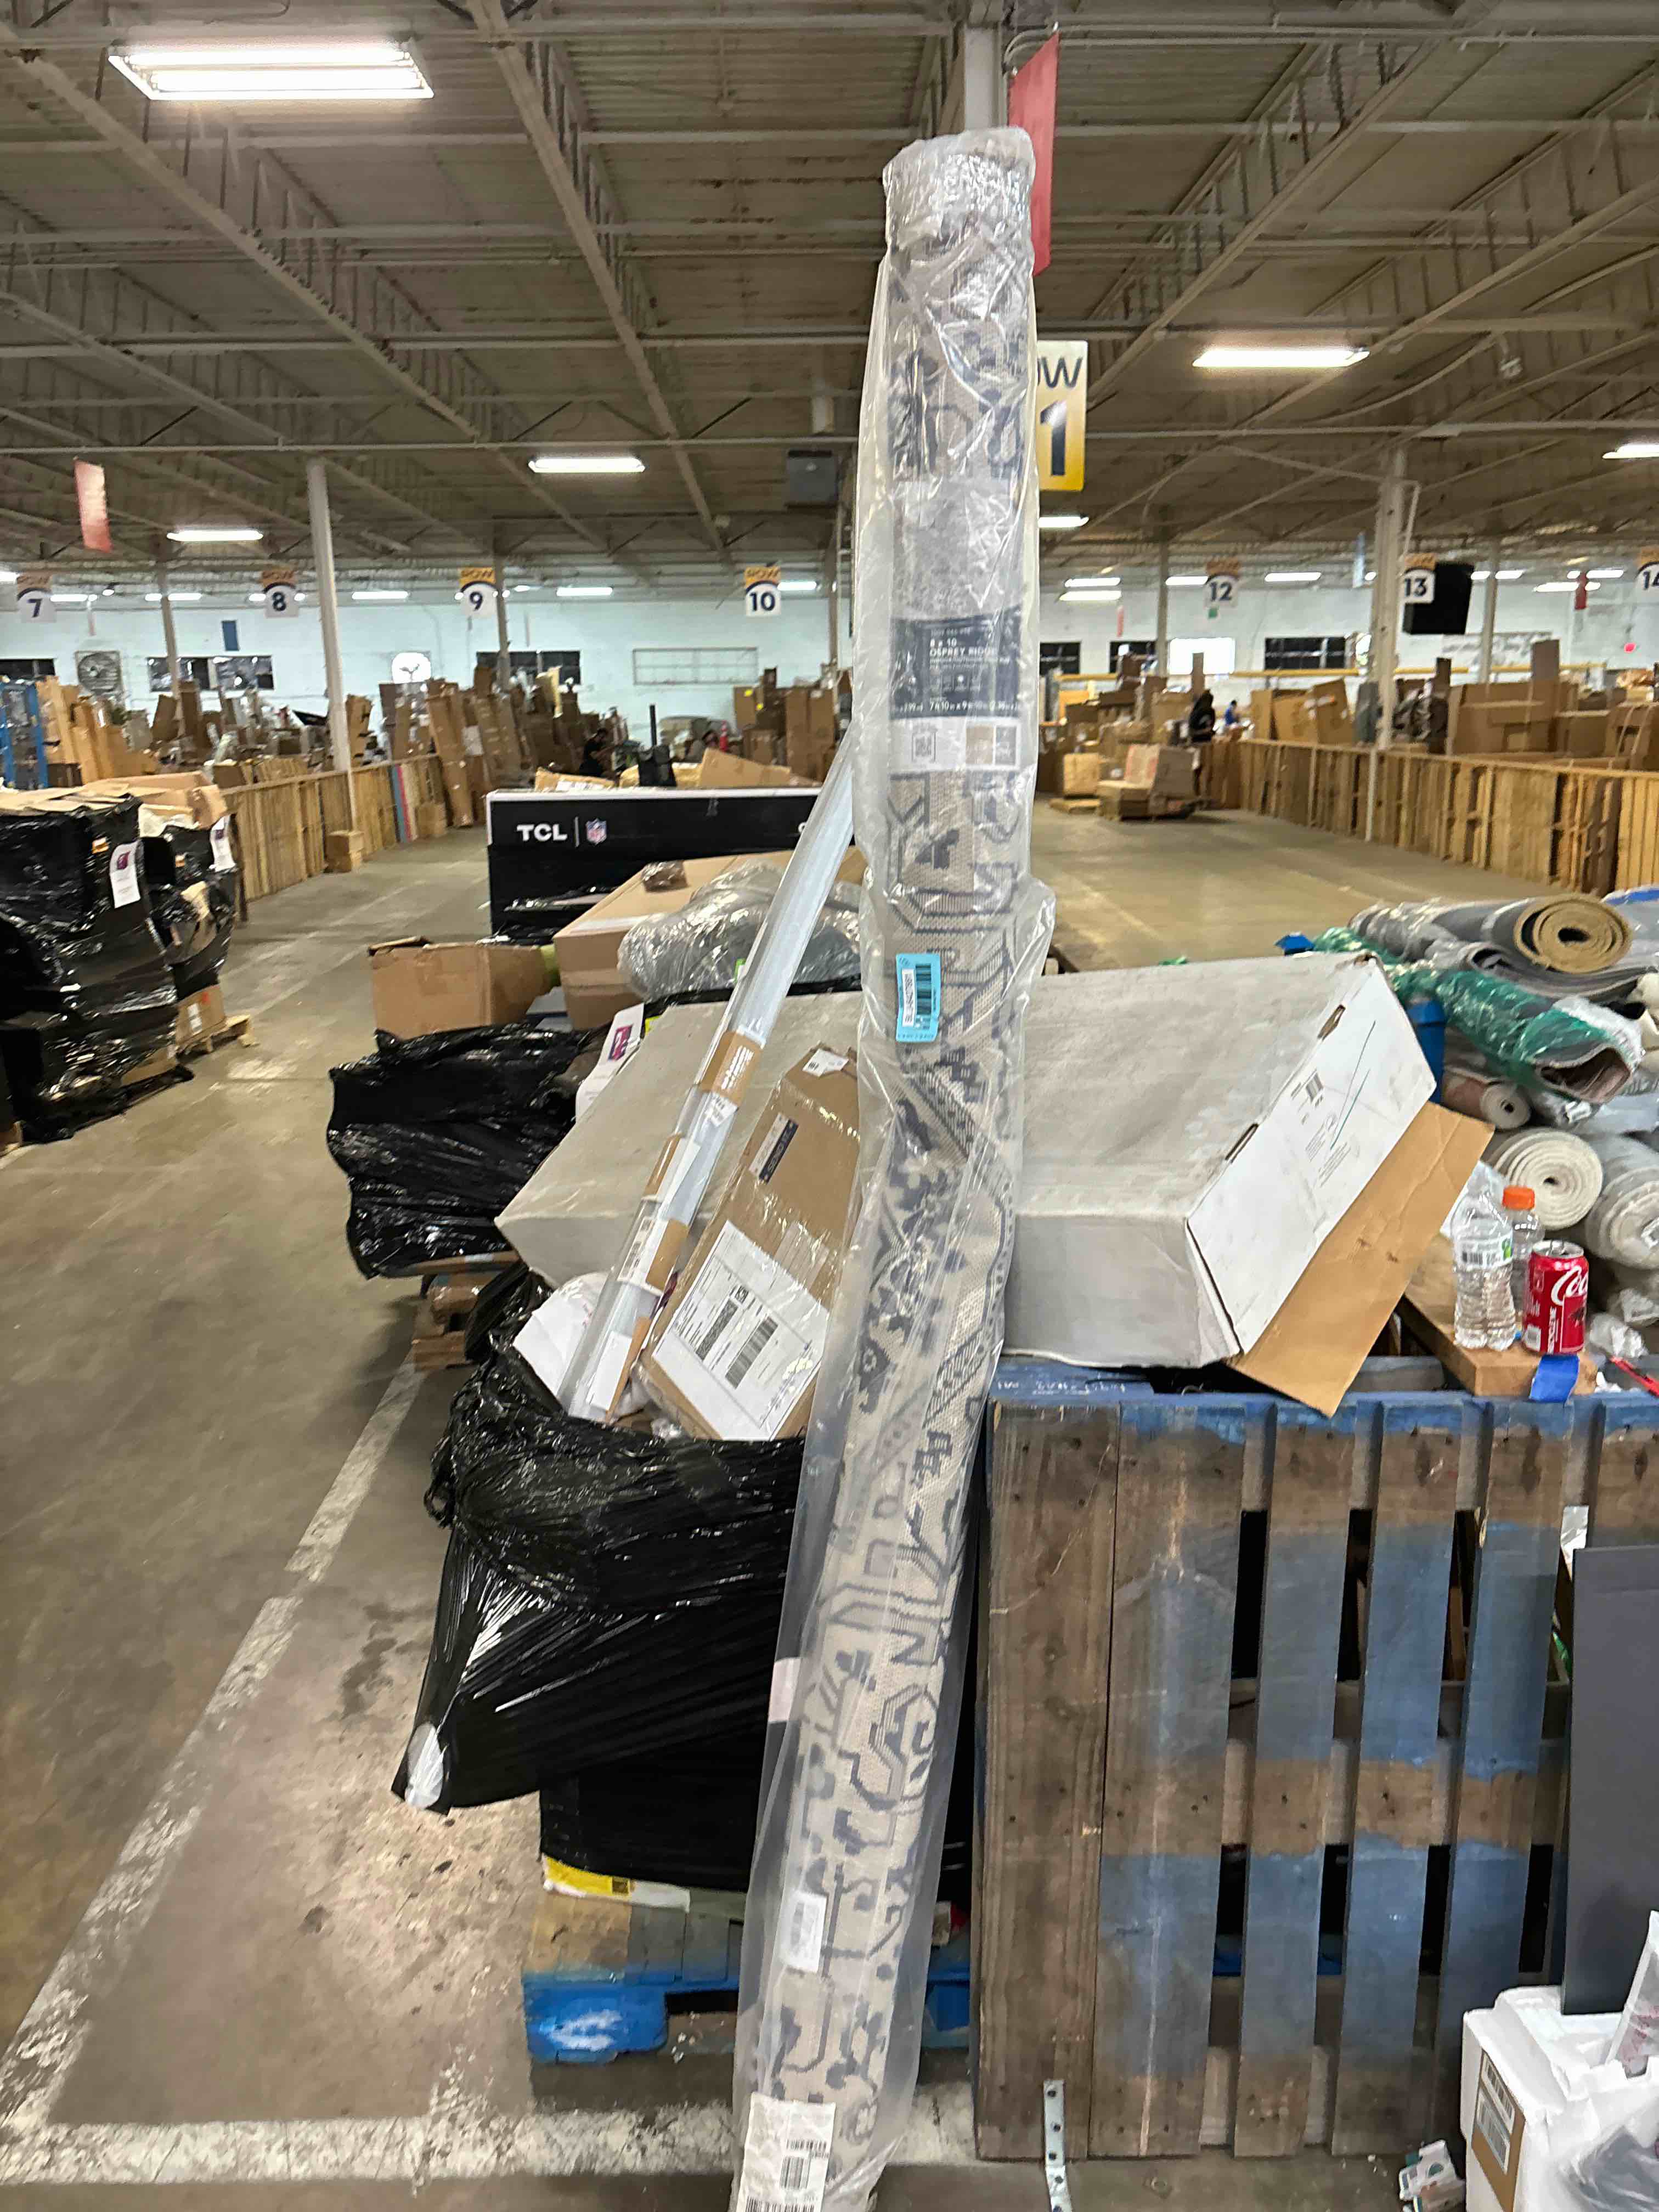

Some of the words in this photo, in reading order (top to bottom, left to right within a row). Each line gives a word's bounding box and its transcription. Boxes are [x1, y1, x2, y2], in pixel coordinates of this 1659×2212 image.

[1209, 582, 1233, 602] 12
[1404, 578, 1427, 597] 13
[27, 598, 43, 618] 7
[272, 591, 286, 612] 8
[469, 591, 483, 611] 9
[749, 591, 776, 612] 10
[516, 823, 568, 842] TCL
